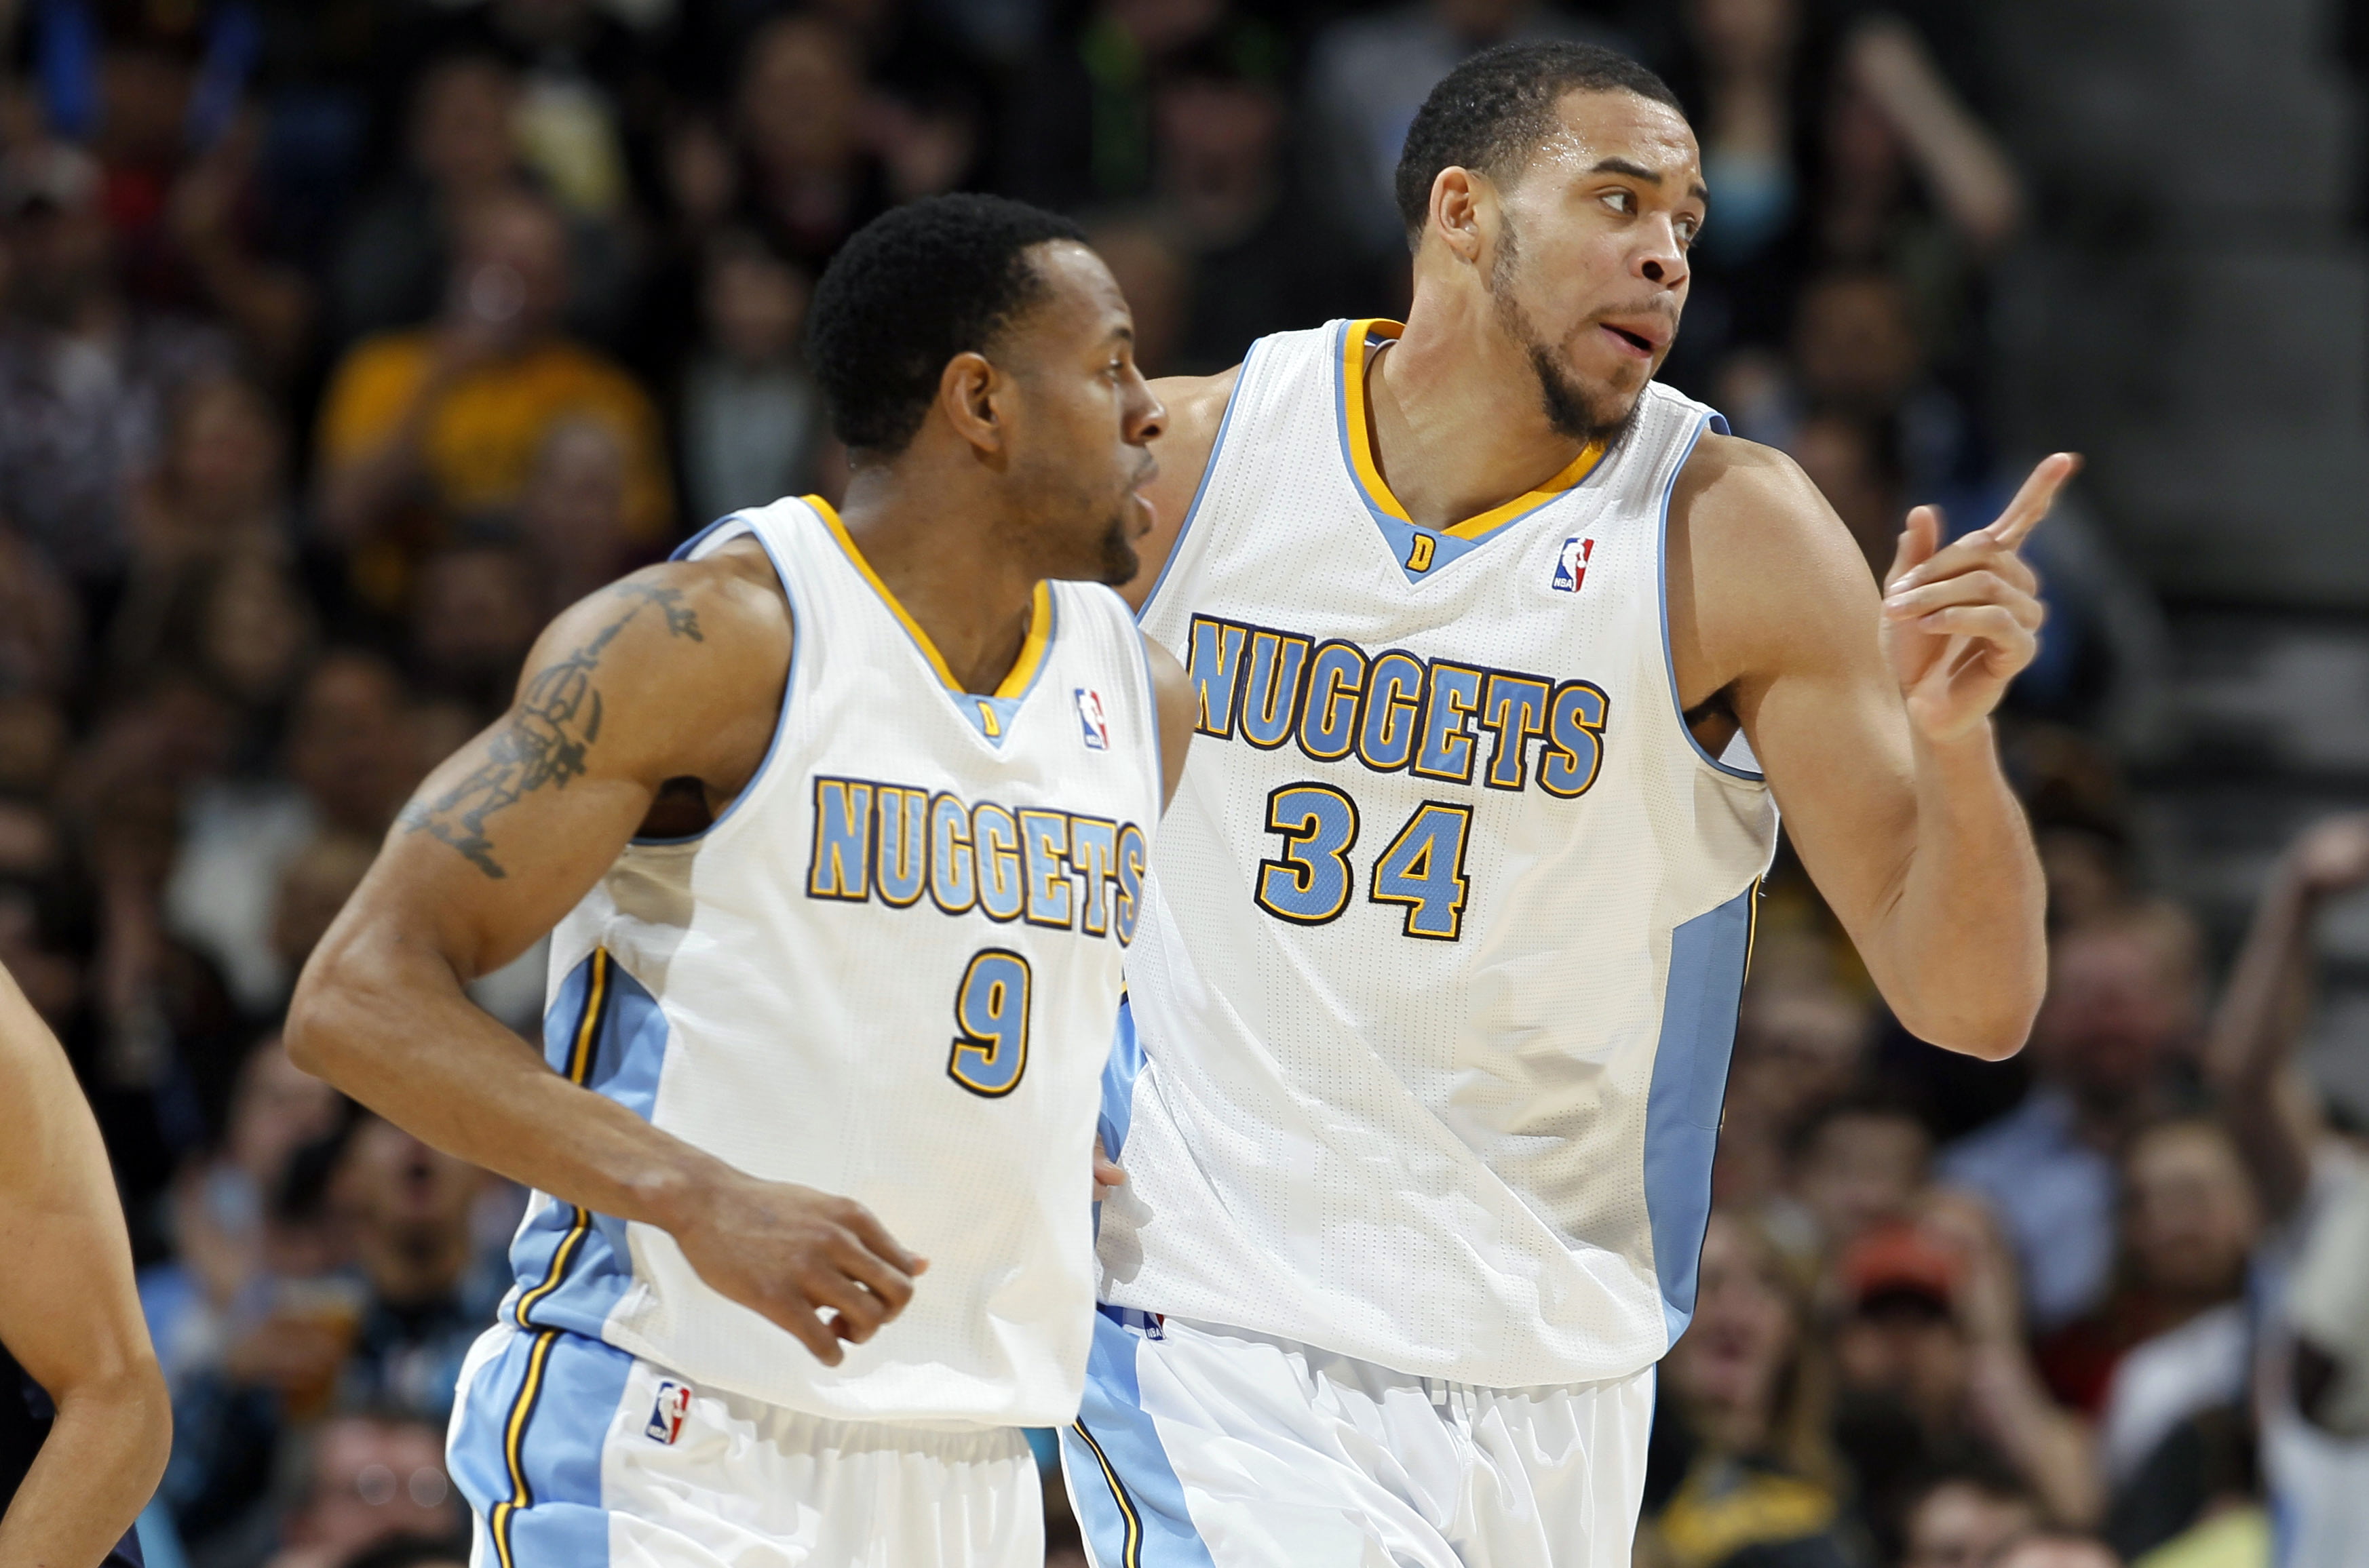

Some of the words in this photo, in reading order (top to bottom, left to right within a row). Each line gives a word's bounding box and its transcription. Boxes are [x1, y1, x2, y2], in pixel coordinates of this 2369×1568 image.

[1406, 534, 1436, 572] D
[1554, 577, 1573, 588] NBA
[976, 701, 1001, 737] D
[1187, 612, 1610, 799] NUGGETS
[807, 775, 1147, 947] NUGGETS
[1254, 781, 1474, 941] 34
[948, 947, 1031, 1098] 9
